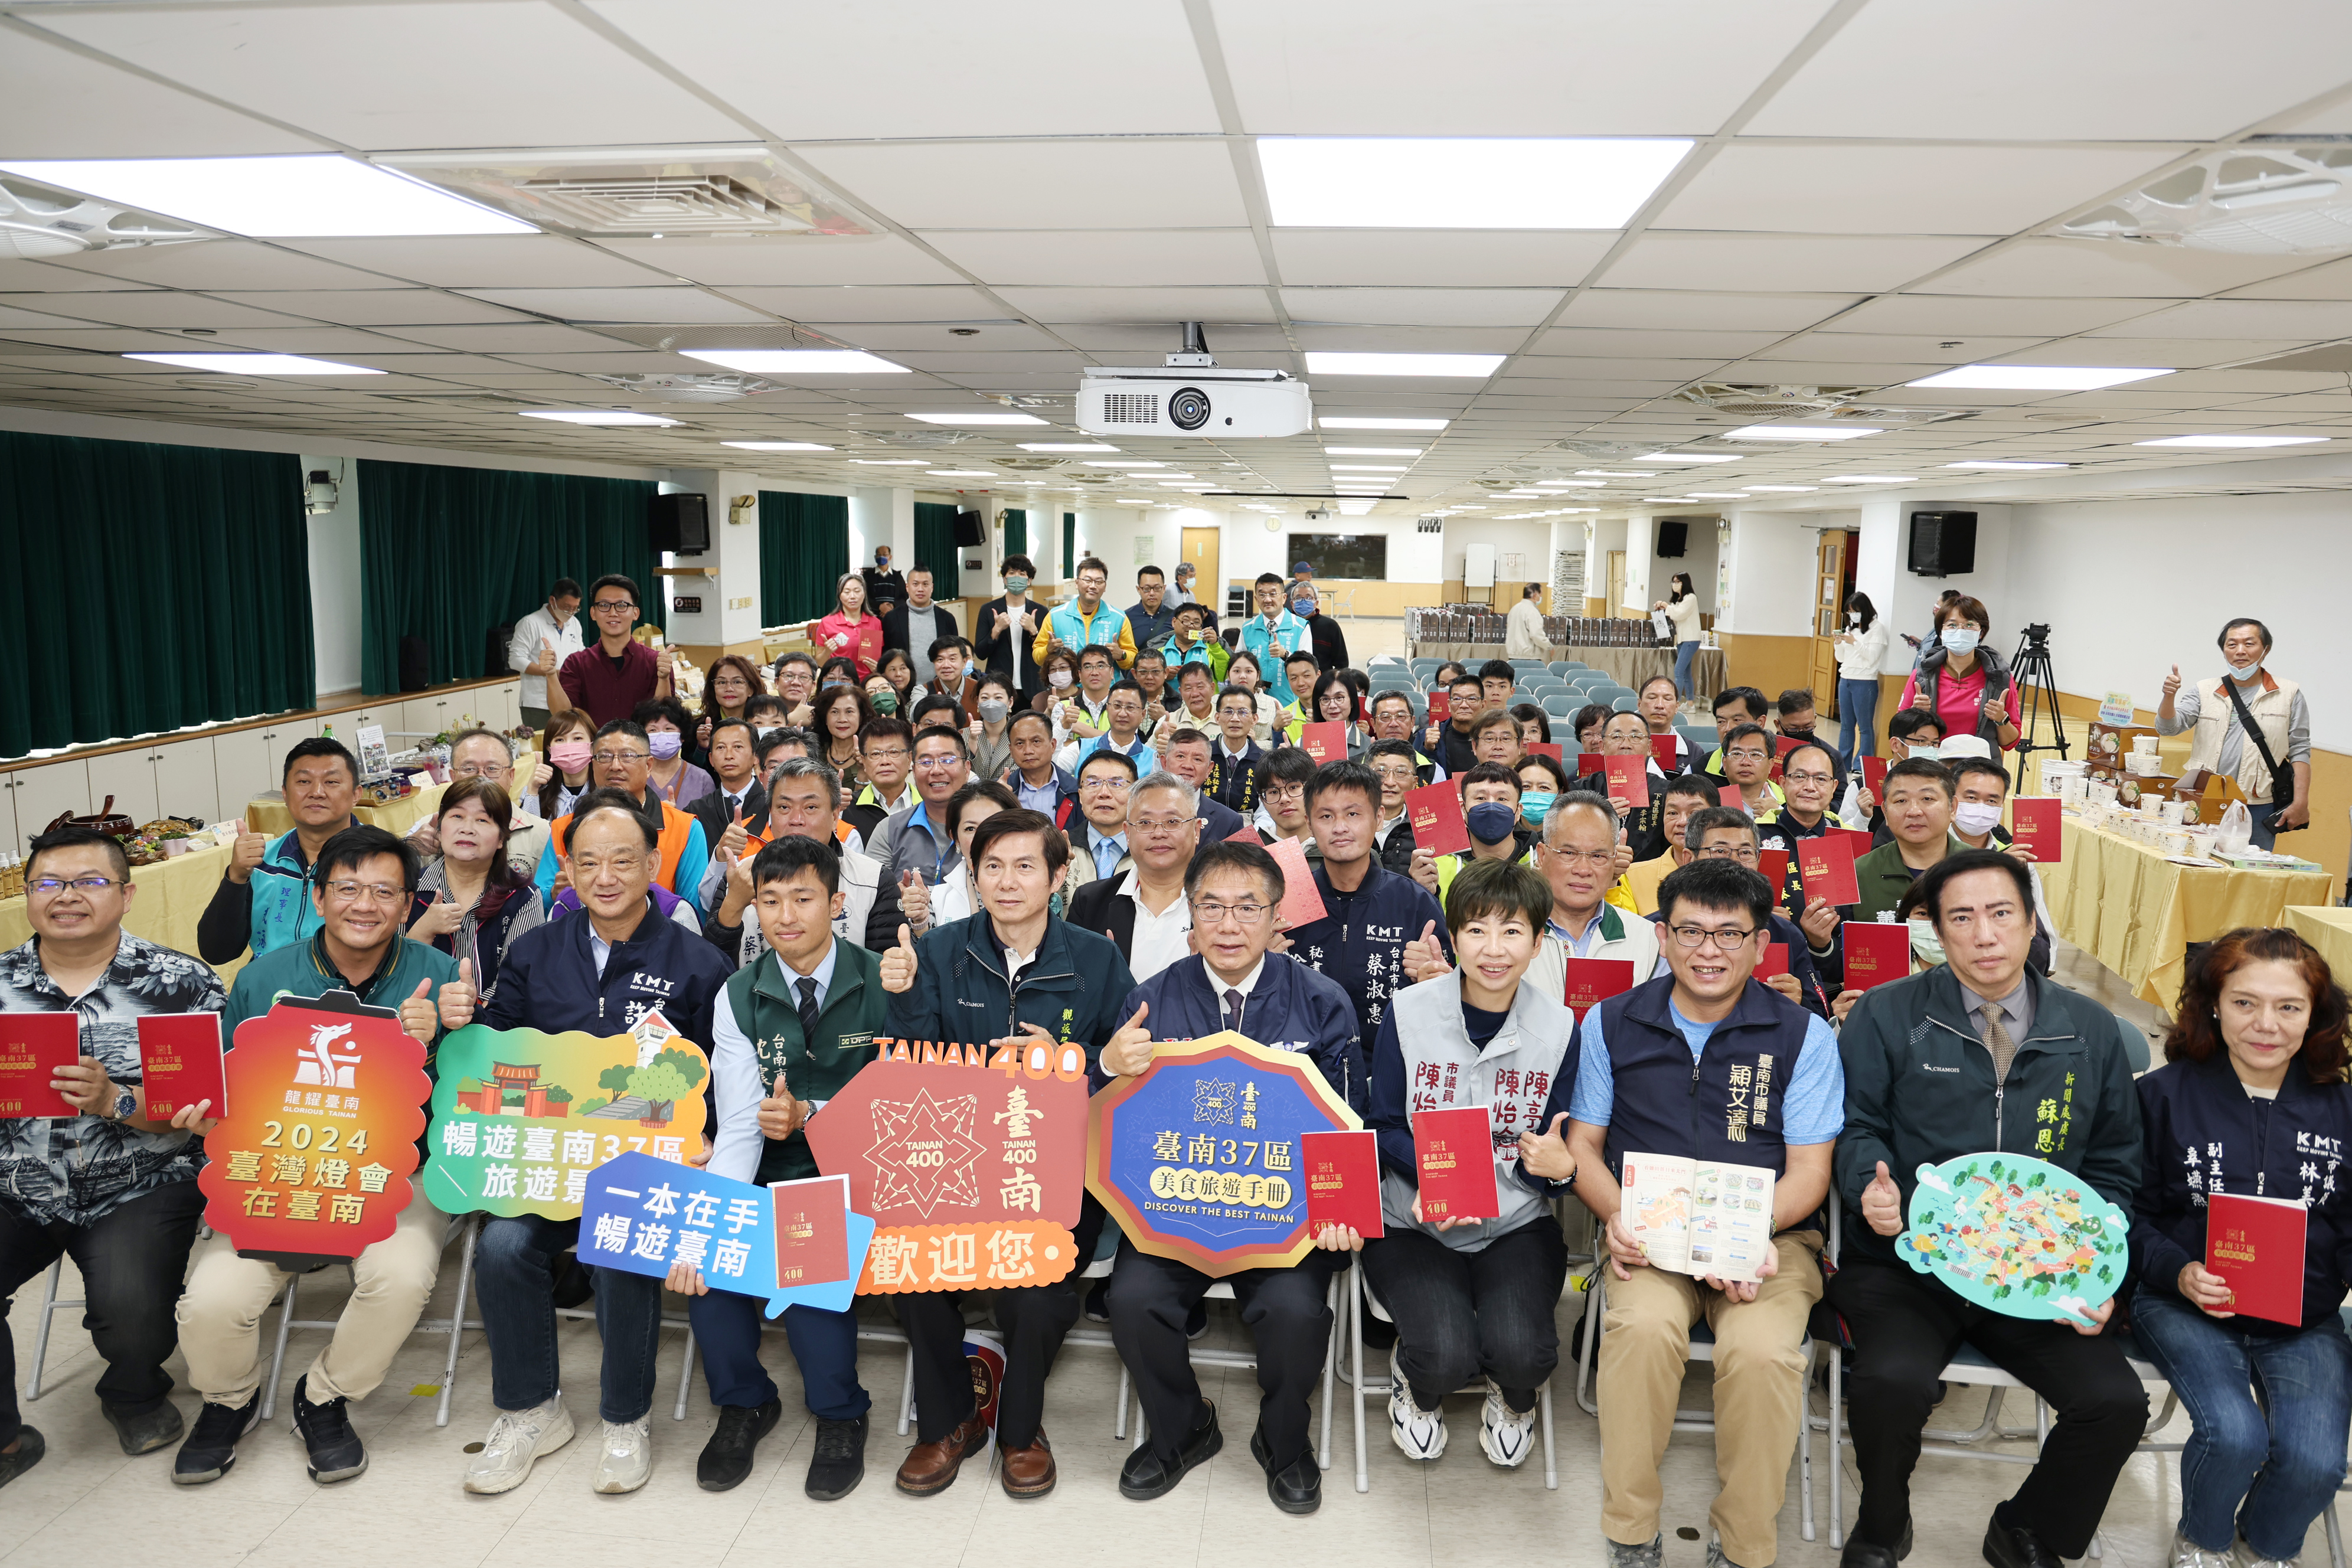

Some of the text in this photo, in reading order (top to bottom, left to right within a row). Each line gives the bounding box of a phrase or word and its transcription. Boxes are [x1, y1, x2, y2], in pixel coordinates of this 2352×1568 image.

[1203, 770, 1213, 797] 添福
[1240, 768, 1254, 811] 東山區公所
[1638, 809, 1647, 832] 李宗翰
[1651, 793, 1662, 827] 下營區區長
[1787, 862, 1802, 891] 區長
[275, 887, 292, 923] 理事長
[1366, 924, 1403, 937] KMT
[632, 972, 675, 991] KMT
[1366, 953, 1387, 1024] 蔡淑惠
[850, 1035, 873, 1044] DPP
[148, 1056, 182, 1064] 臺南37區
[1413, 1061, 1441, 1111] 陳怡
[1442, 1062, 1459, 1103] 市議員
[1753, 1053, 1773, 1126] 臺南市議員
[152, 1103, 172, 1113] 400
[283, 1106, 324, 1115] GLORIOUS
[285, 1090, 360, 1110] 龍耀臺南
[992, 1084, 1044, 1138] 臺
[1522, 1070, 1549, 1133] 陳亭
[2057, 1072, 2075, 1151] 新聞處處長
[261, 1121, 368, 1155] 2024
[443, 1121, 685, 1165] 暢遊臺南37區
[906, 1140, 943, 1151] TAINAN
[1002, 1140, 1036, 1149] TAINAN
[2035, 1098, 2059, 1162] 蘇恩
[2297, 1131, 2341, 1152] KMT
[906, 1151, 944, 1168] 400
[1002, 1149, 1037, 1165] 400
[1152, 1130, 1293, 1172] 臺南37區
[1422, 1152, 1455, 1162] 臺南37區
[2207, 1142, 2224, 1193] 副主任
[225, 1150, 394, 1194] 臺灣燈會
[1156, 1171, 1288, 1204] 美食旅遊手冊
[1311, 1174, 1342, 1182] 臺南37區
[242, 1186, 366, 1224] 在臺南
[999, 1167, 1042, 1213] 南
[605, 1182, 759, 1234] 一本在手
[1144, 1201, 1294, 1223] DISCOVER THE BEST TAINAN
[1427, 1202, 1448, 1214] 400
[592, 1213, 751, 1277] 暢遊臺南
[869, 1230, 1036, 1288] 歡迎您
[2215, 1240, 2255, 1253] 臺南37區
